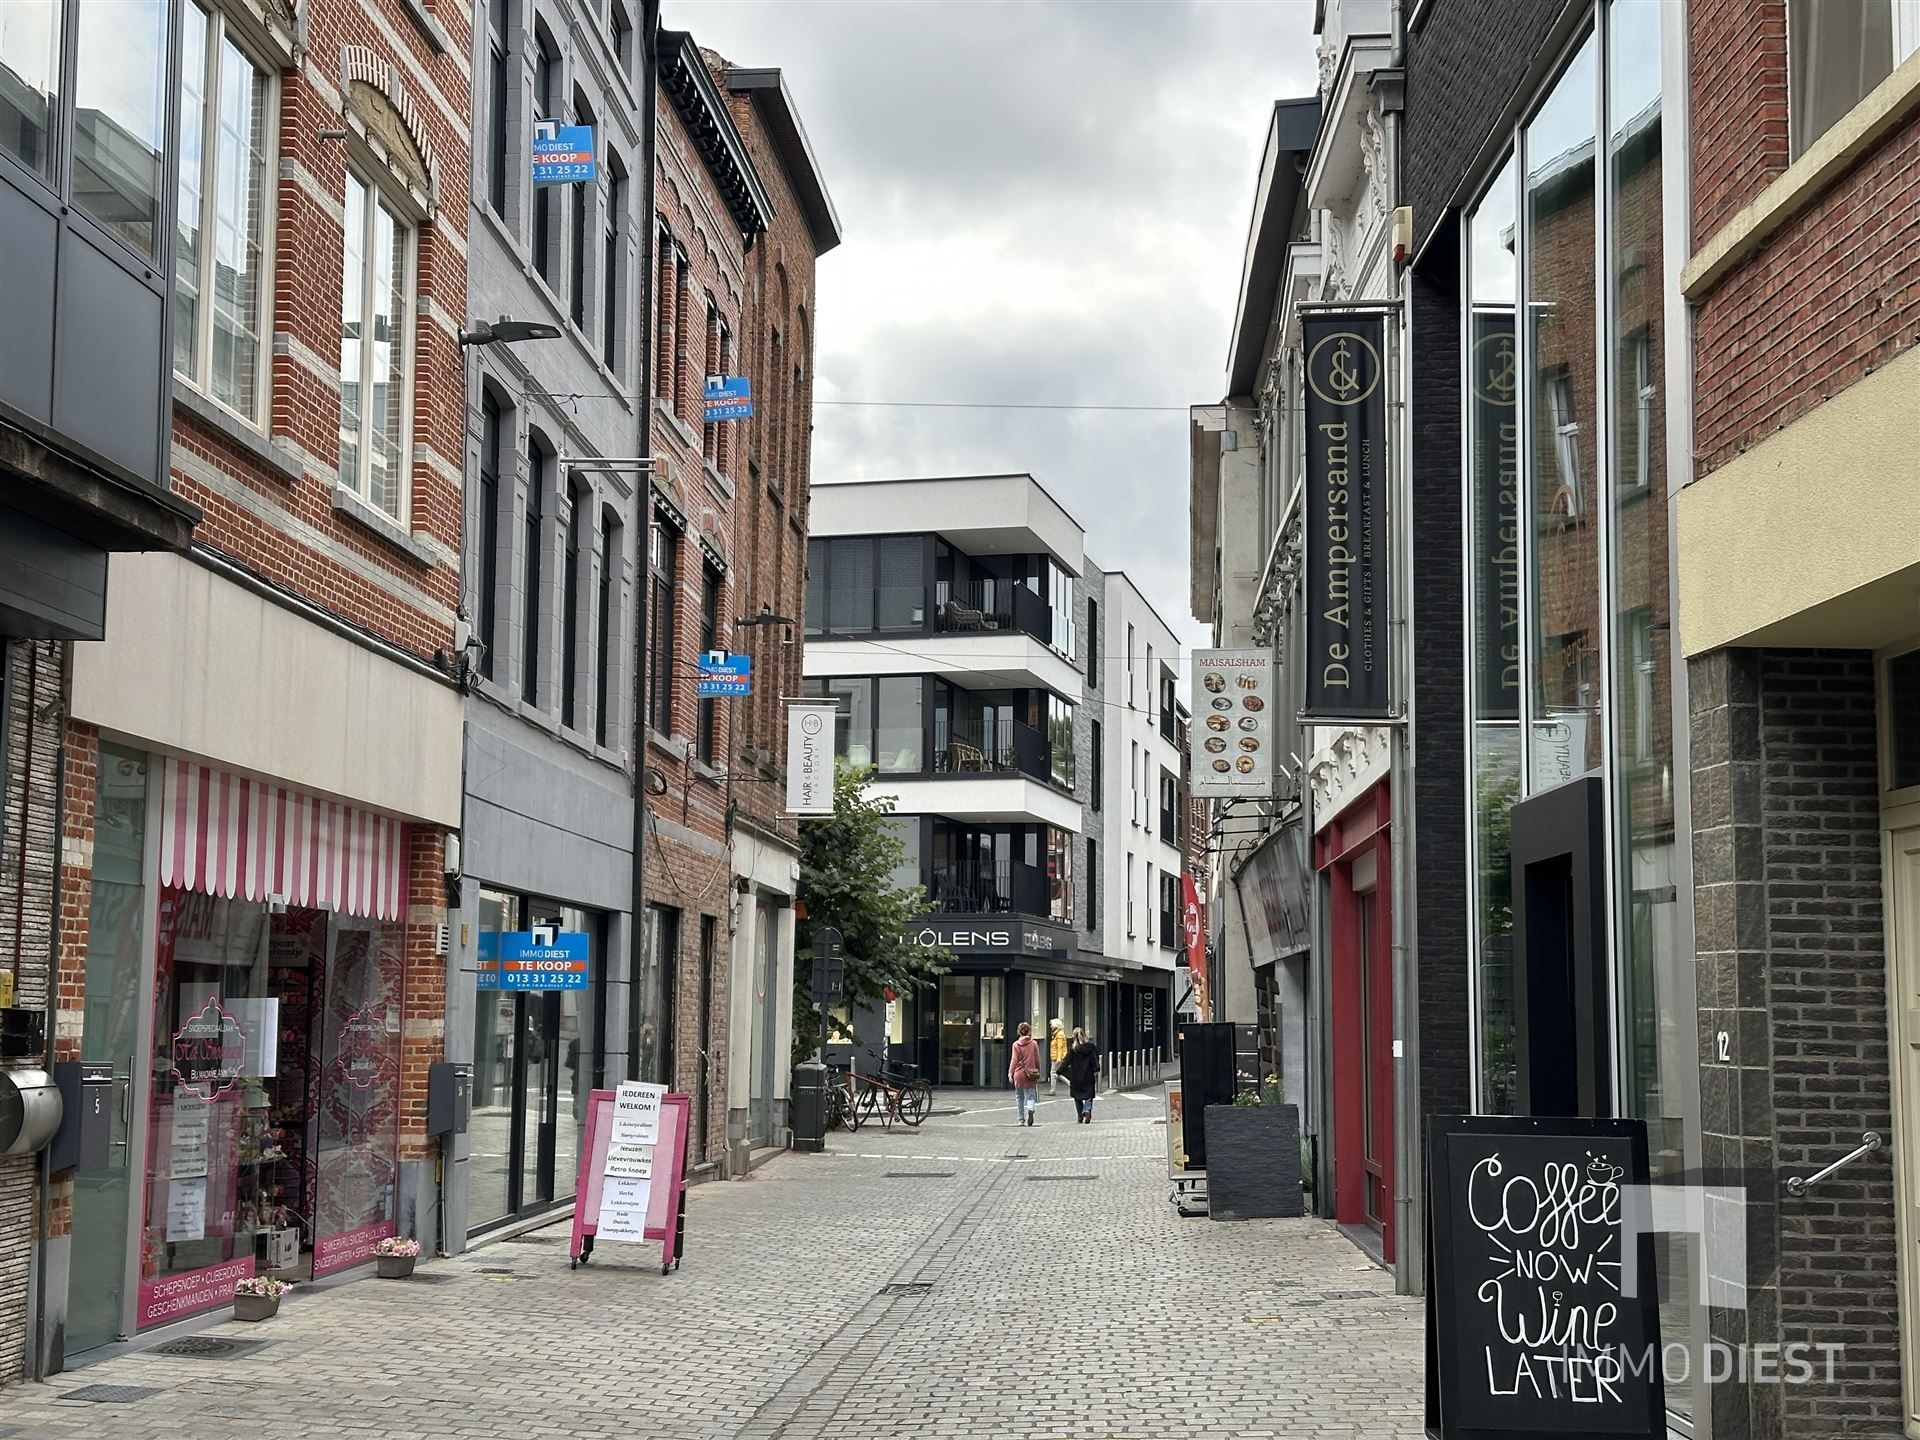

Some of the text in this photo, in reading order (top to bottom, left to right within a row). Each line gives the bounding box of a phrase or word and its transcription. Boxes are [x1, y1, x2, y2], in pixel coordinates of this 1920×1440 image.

[542, 153, 577, 163] KOOP
[549, 143, 575, 151] DIEST
[540, 166, 552, 175] 31
[557, 165, 571, 174] 25
[574, 164, 588, 174] 22
[714, 398, 739, 407] KOOP
[718, 390, 737, 398] DIEST
[712, 408, 722, 416] 31
[724, 407, 735, 415] 25
[1361, 438, 1371, 477] LUNCH
[1362, 494, 1372, 558] BREAKFAST
[1318, 421, 1357, 689] De Ampersand
[1363, 571, 1372, 604] GIFTS
[1364, 619, 1373, 672] CLOTHES
[1199, 658, 1266, 667] MAISALSHAM
[712, 674, 738, 682] KOOP
[803, 735, 814, 774] BEAUTY
[803, 782, 812, 806] HAIR
[900, 927, 1010, 949] OLENS
[520, 949, 570, 958] IMMO DIEST
[517, 960, 572, 971] TE KOOP
[507, 973, 581, 984] 013 31 25 22
[1143, 992, 1153, 1032] TRIXXO
[1716, 1031, 1730, 1061] 12
[622, 1089, 656, 1100] IEDEREEN
[94, 1098, 100, 1114] 5
[619, 1101, 651, 1111] WELKOM
[609, 1165, 648, 1175] Retro Snoep
[1468, 1152, 1622, 1250] Coffee
[1515, 1249, 1594, 1284] NOW
[153, 1274, 201, 1300] SCHEPSNOEP
[147, 1289, 214, 1318] GESCHENKMANDEN
[1477, 1278, 1617, 1352] Wine
[1484, 1345, 1623, 1403] LATER
